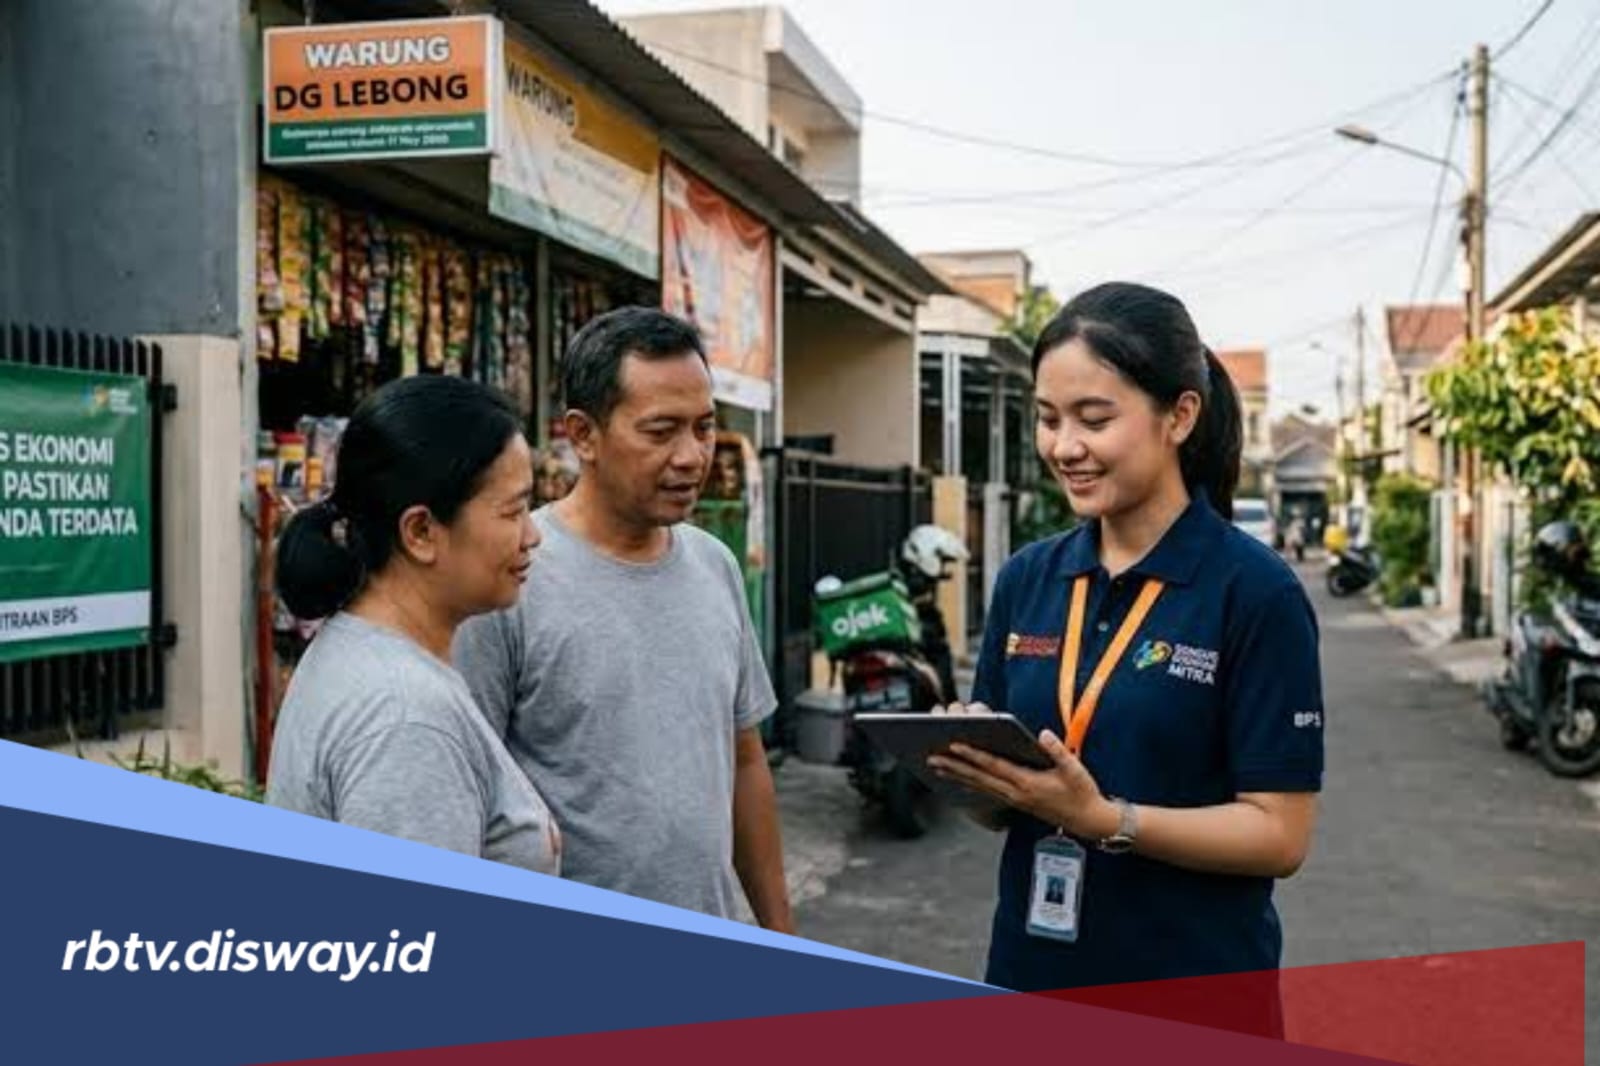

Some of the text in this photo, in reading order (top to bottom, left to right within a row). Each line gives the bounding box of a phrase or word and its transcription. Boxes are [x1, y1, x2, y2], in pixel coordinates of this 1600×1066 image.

[304, 35, 451, 69] WARUNG
[274, 74, 469, 111] DG LEBONG
[507, 61, 576, 127] WARUNG
[15, 432, 114, 466] EKONOMI
[3, 469, 110, 501] PASTIKAN
[47, 506, 139, 537] TERDATA
[52, 605, 78, 626] BPS
[831, 600, 890, 639] ojek
[1167, 662, 1216, 686] MITRA
